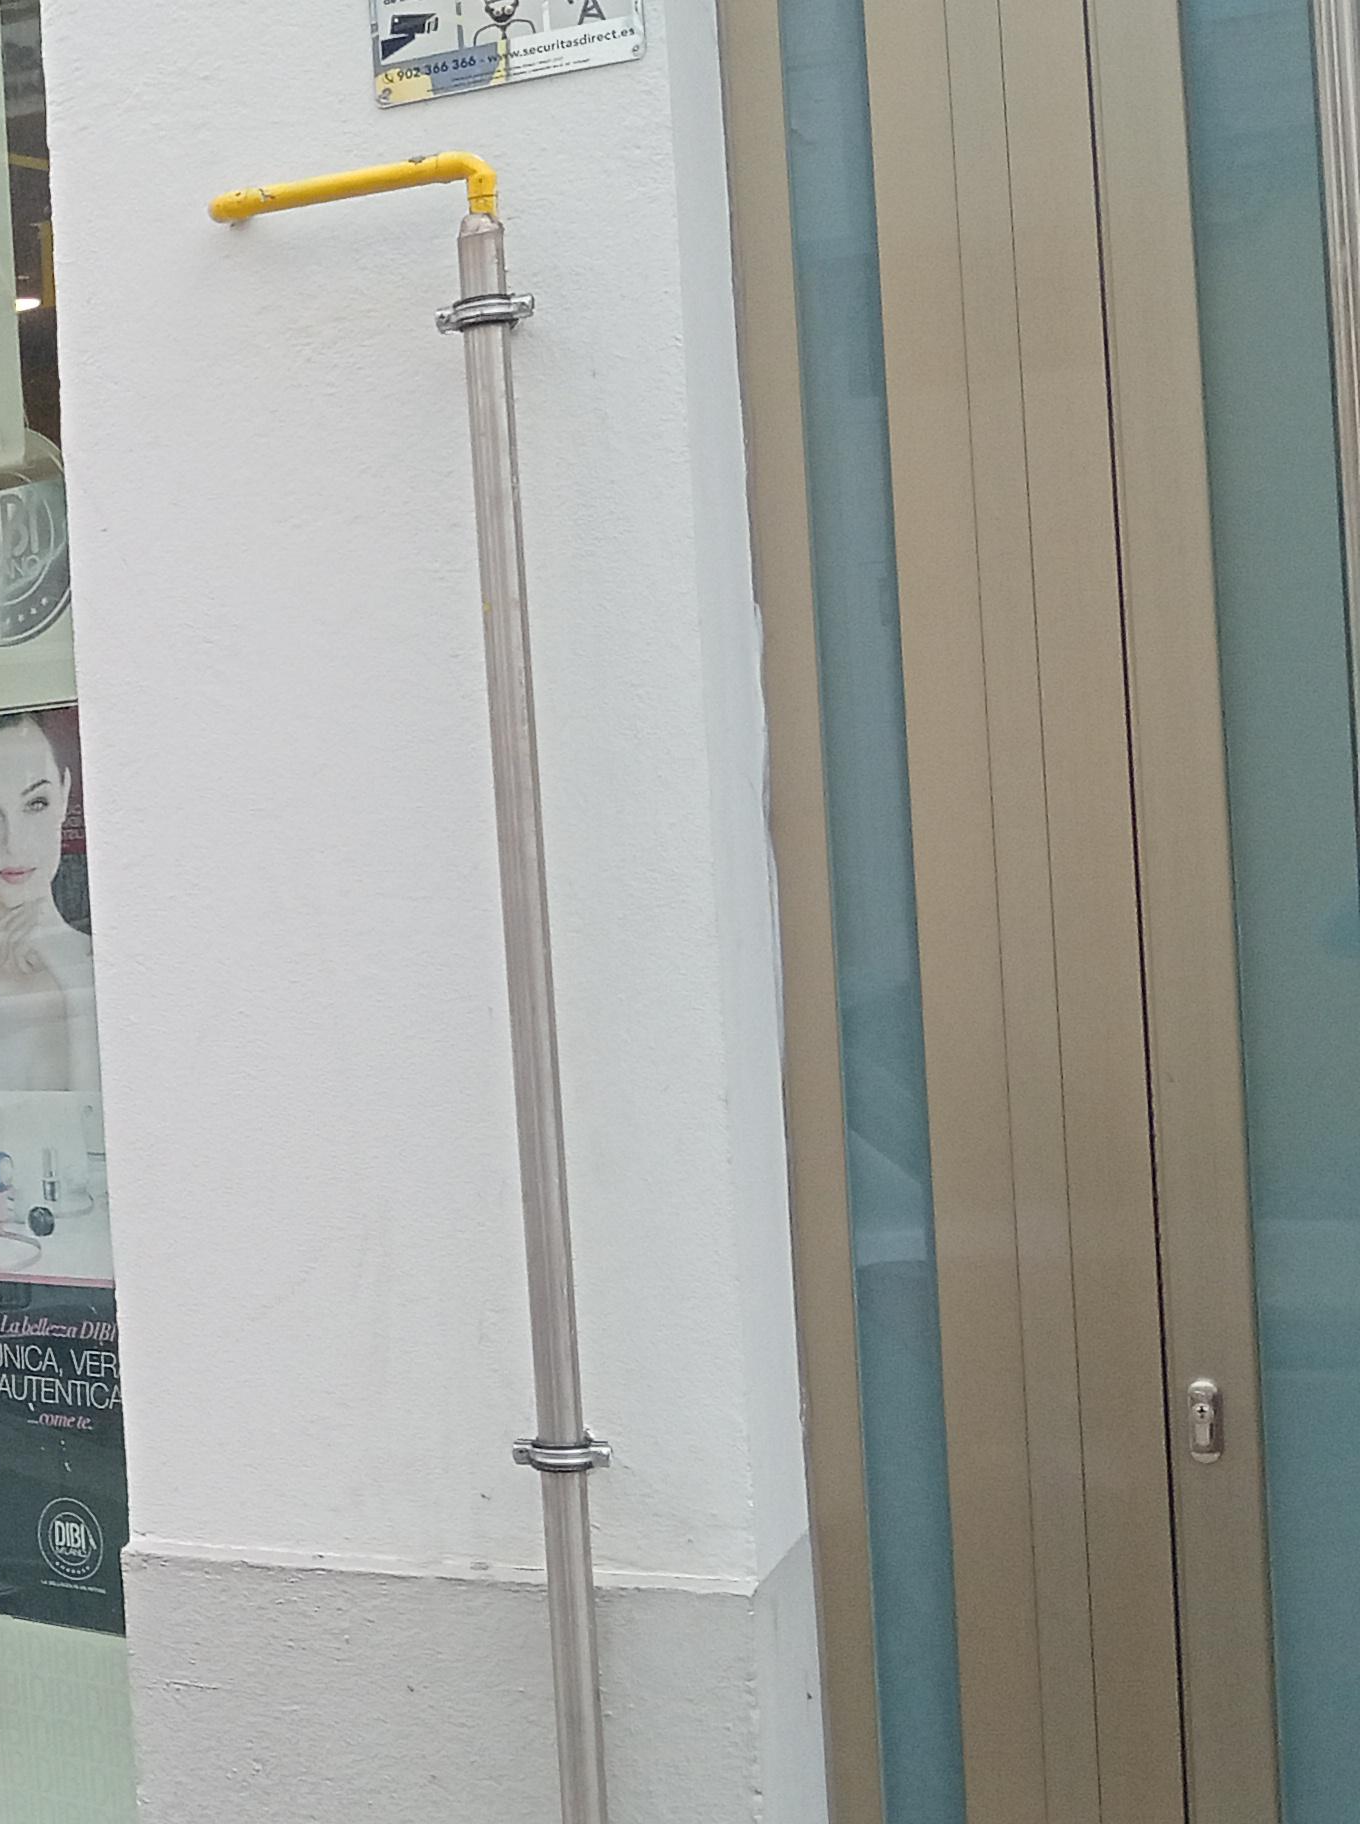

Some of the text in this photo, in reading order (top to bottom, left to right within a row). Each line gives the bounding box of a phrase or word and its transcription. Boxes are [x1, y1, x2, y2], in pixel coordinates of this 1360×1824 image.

[396, 67, 420, 82] 902
[425, 61, 449, 76] 366
[452, 55, 477, 70] 366
[55, 1520, 86, 1552] DIBI
